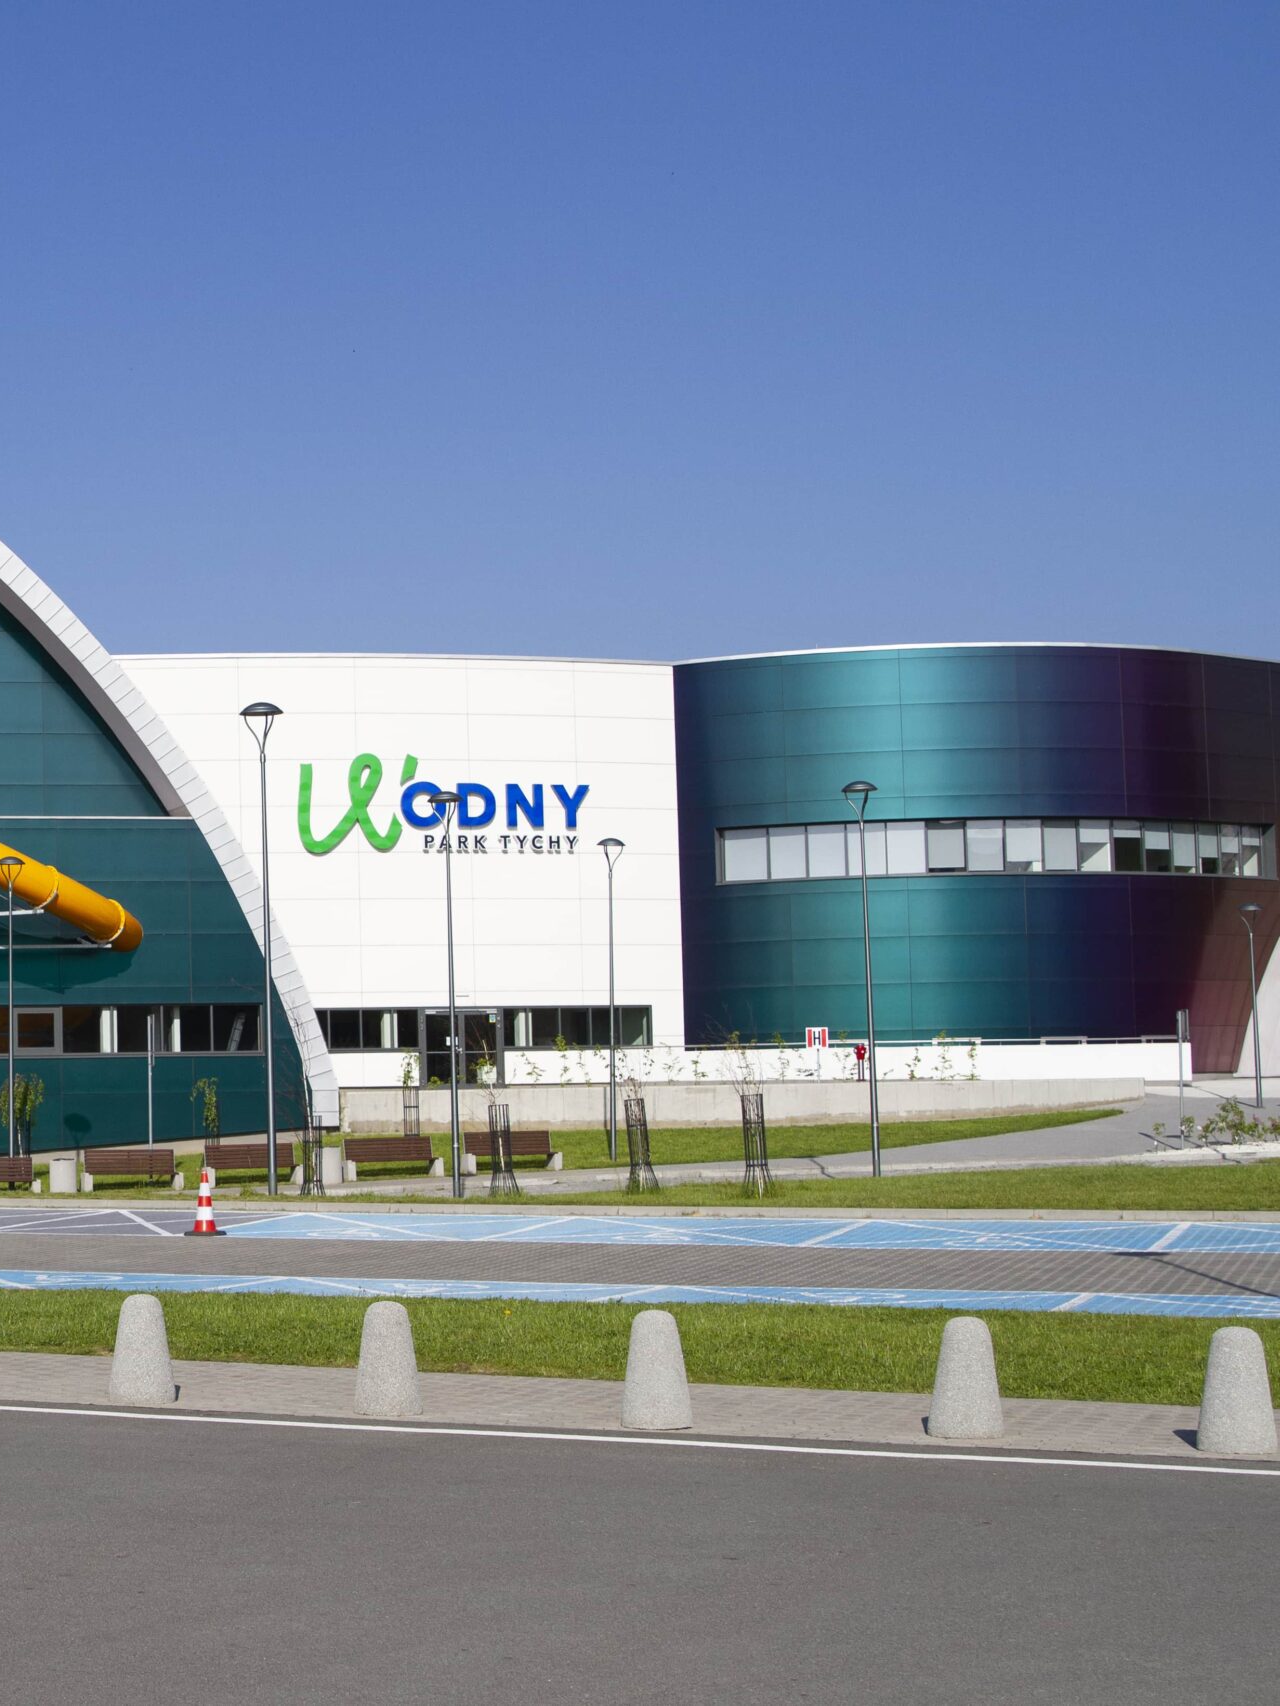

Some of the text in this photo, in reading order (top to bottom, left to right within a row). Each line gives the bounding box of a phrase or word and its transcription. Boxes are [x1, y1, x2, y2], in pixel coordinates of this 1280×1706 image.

[424, 835, 578, 850] PARK TYCHY
[813, 1031, 821, 1046] H
